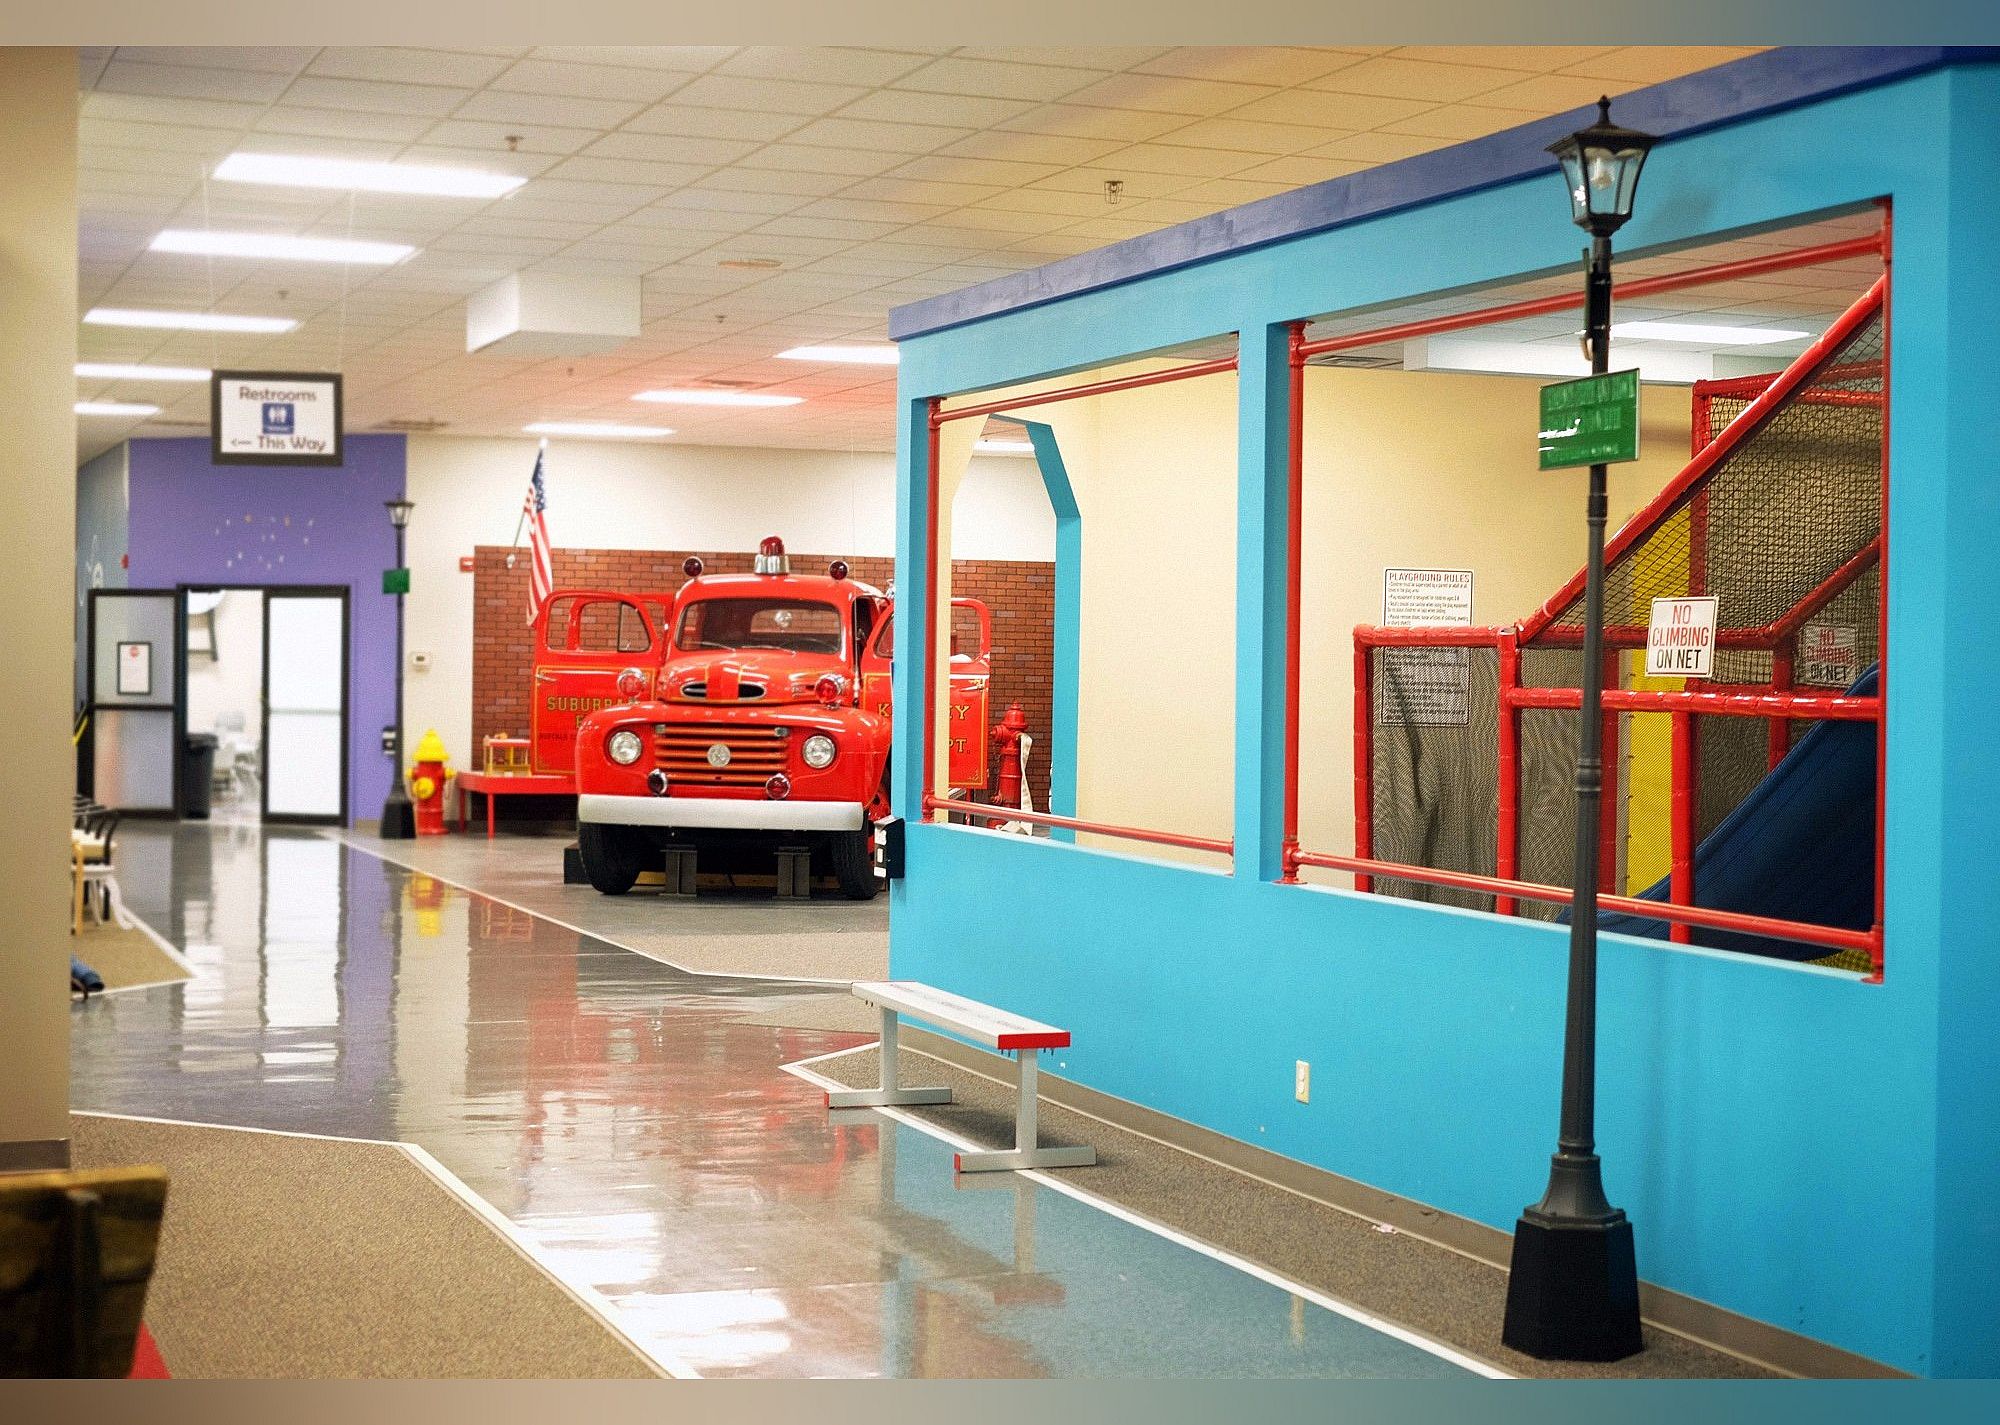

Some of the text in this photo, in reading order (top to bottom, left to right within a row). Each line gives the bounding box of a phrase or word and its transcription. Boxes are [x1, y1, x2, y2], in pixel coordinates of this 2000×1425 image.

[239, 386, 317, 402] Restrooms
[257, 435, 327, 452] This Way
[1389, 572, 1470, 583] PLAYGROUND RULES
[1672, 604, 1692, 625] NO
[1652, 626, 1710, 647] CLIMBING
[1656, 649, 1702, 669] ON NET
